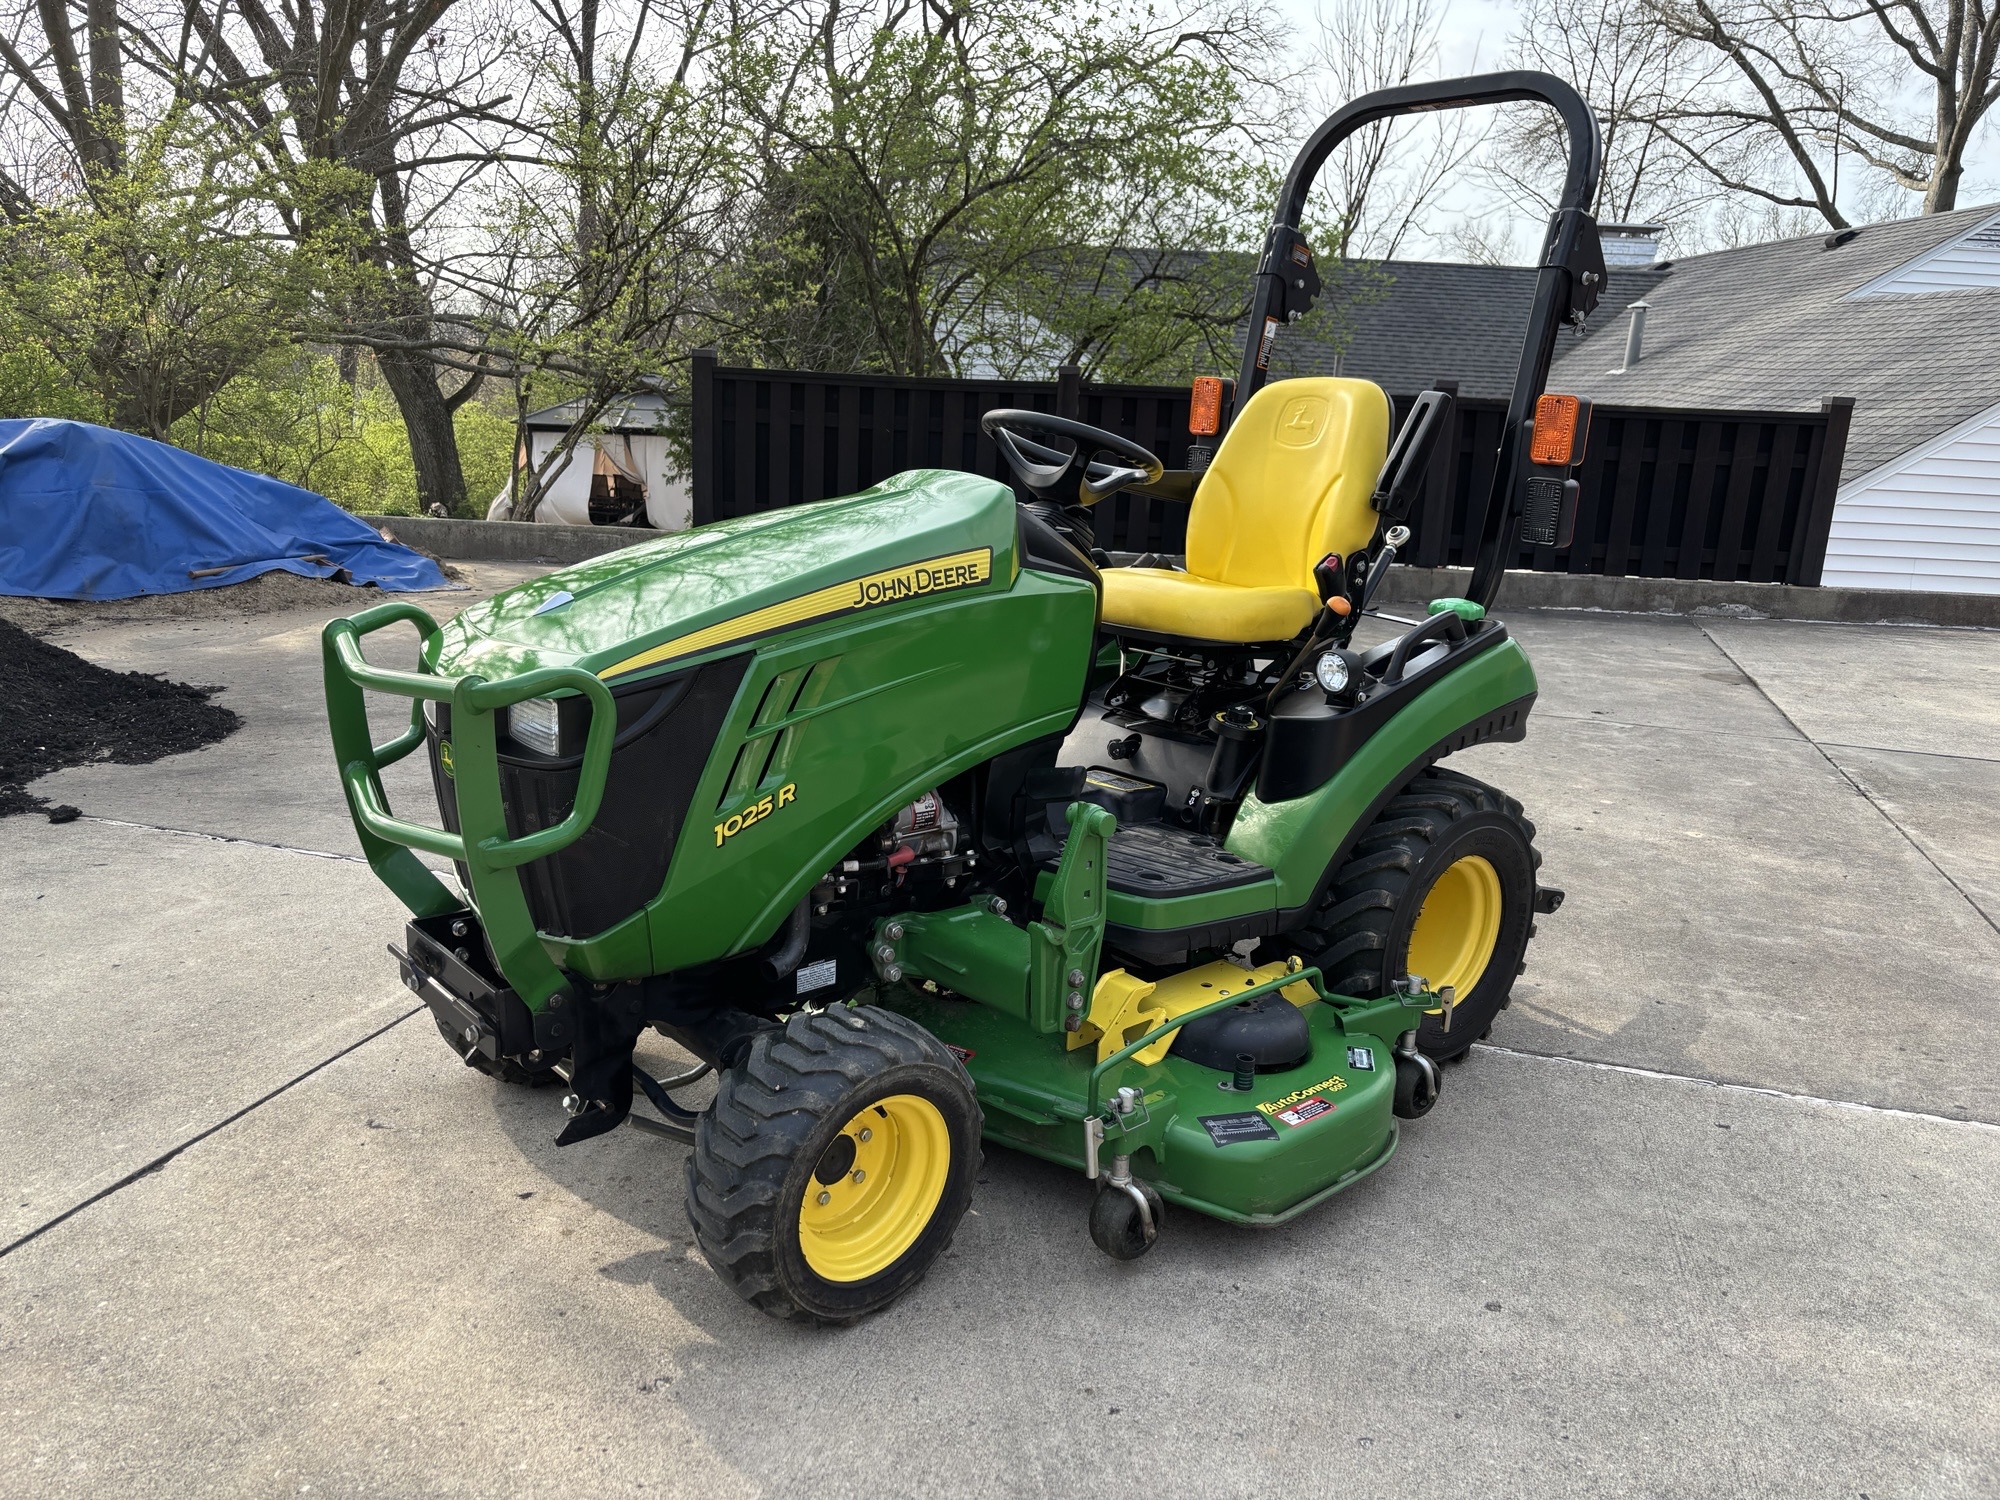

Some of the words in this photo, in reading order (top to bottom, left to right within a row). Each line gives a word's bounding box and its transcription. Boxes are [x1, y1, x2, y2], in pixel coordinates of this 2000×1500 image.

[853, 575, 912, 606] JOHN
[915, 563, 979, 591] DEERE
[714, 795, 774, 848] 1025
[778, 783, 797, 809] R
[1262, 1075, 1345, 1114] AutoConnect
